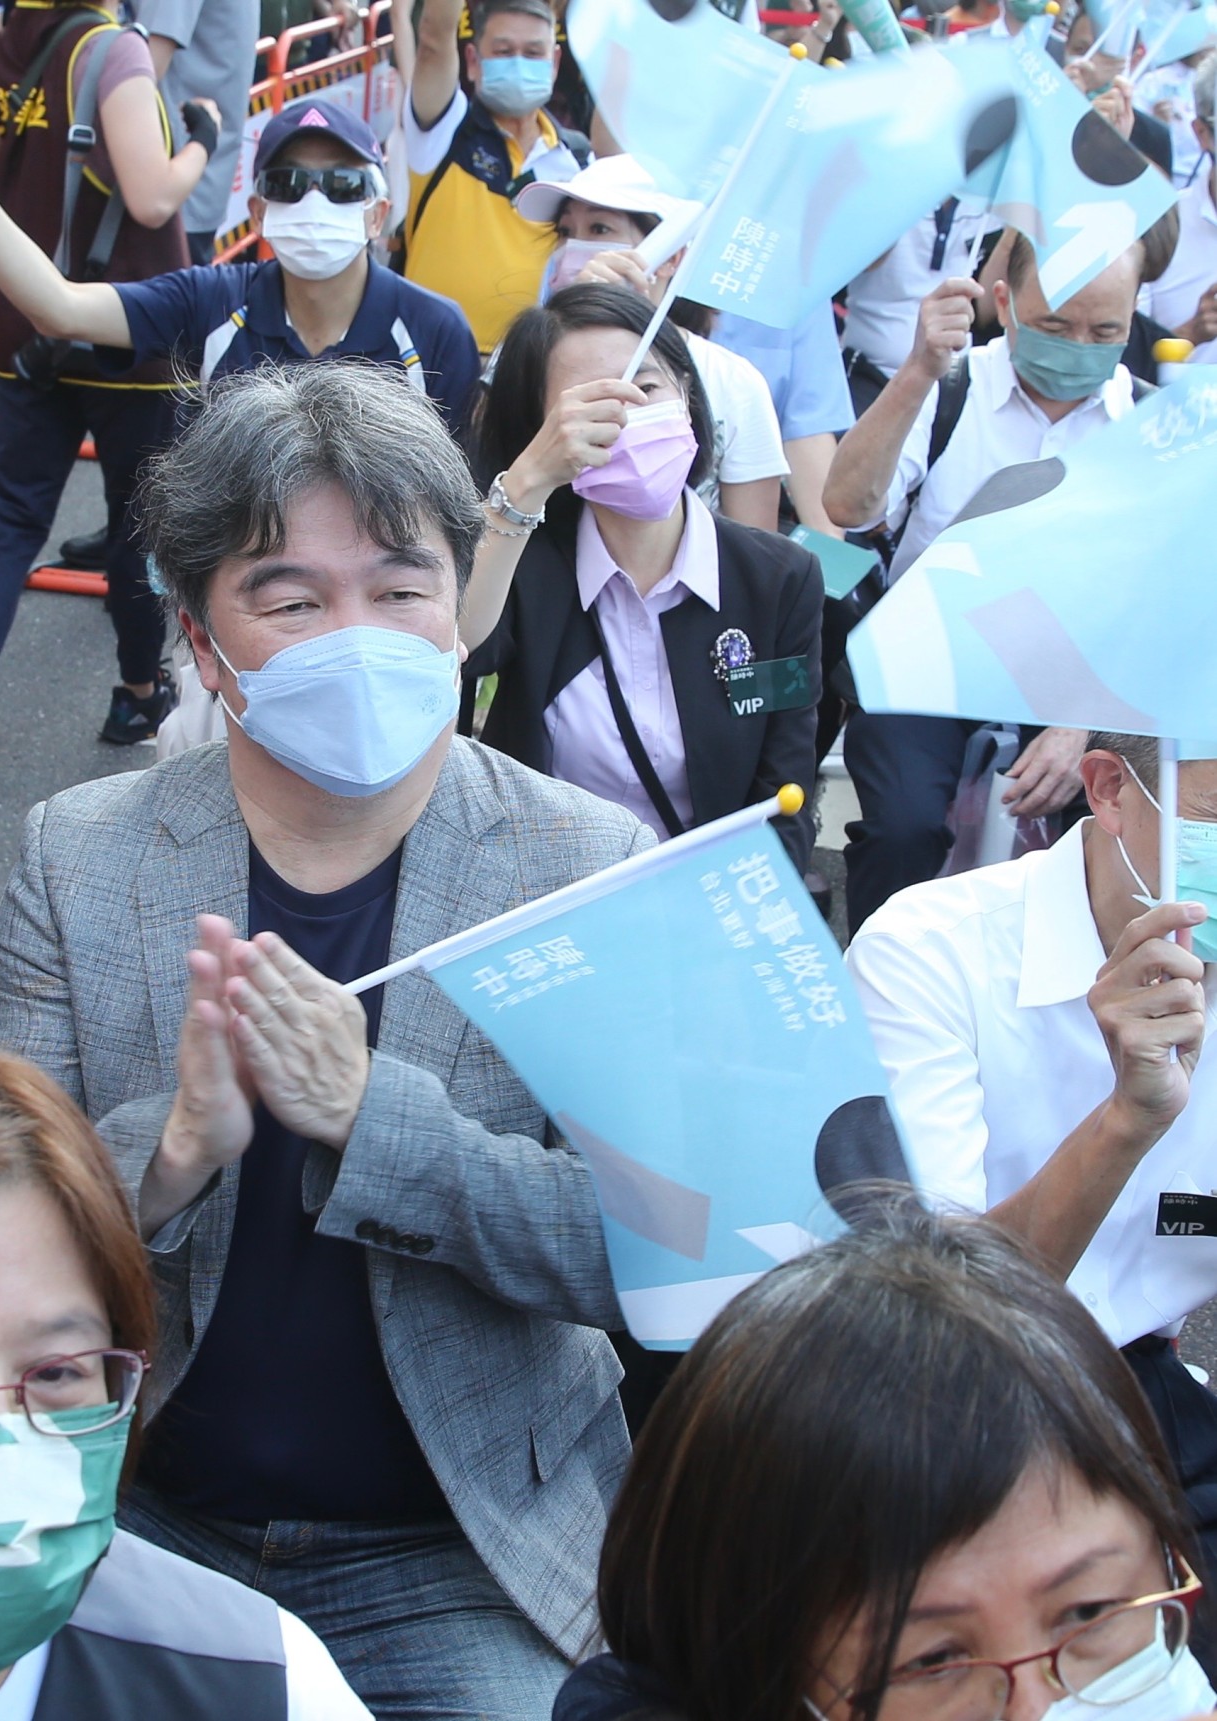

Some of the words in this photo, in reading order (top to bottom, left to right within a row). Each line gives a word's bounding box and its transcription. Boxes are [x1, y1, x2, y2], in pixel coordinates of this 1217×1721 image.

[710, 216, 766, 296] 陳時中
[733, 697, 764, 716] VIP
[471, 934, 587, 998] 陳時中
[727, 851, 848, 1029] 把事做好
[1162, 1221, 1205, 1235] VIP
